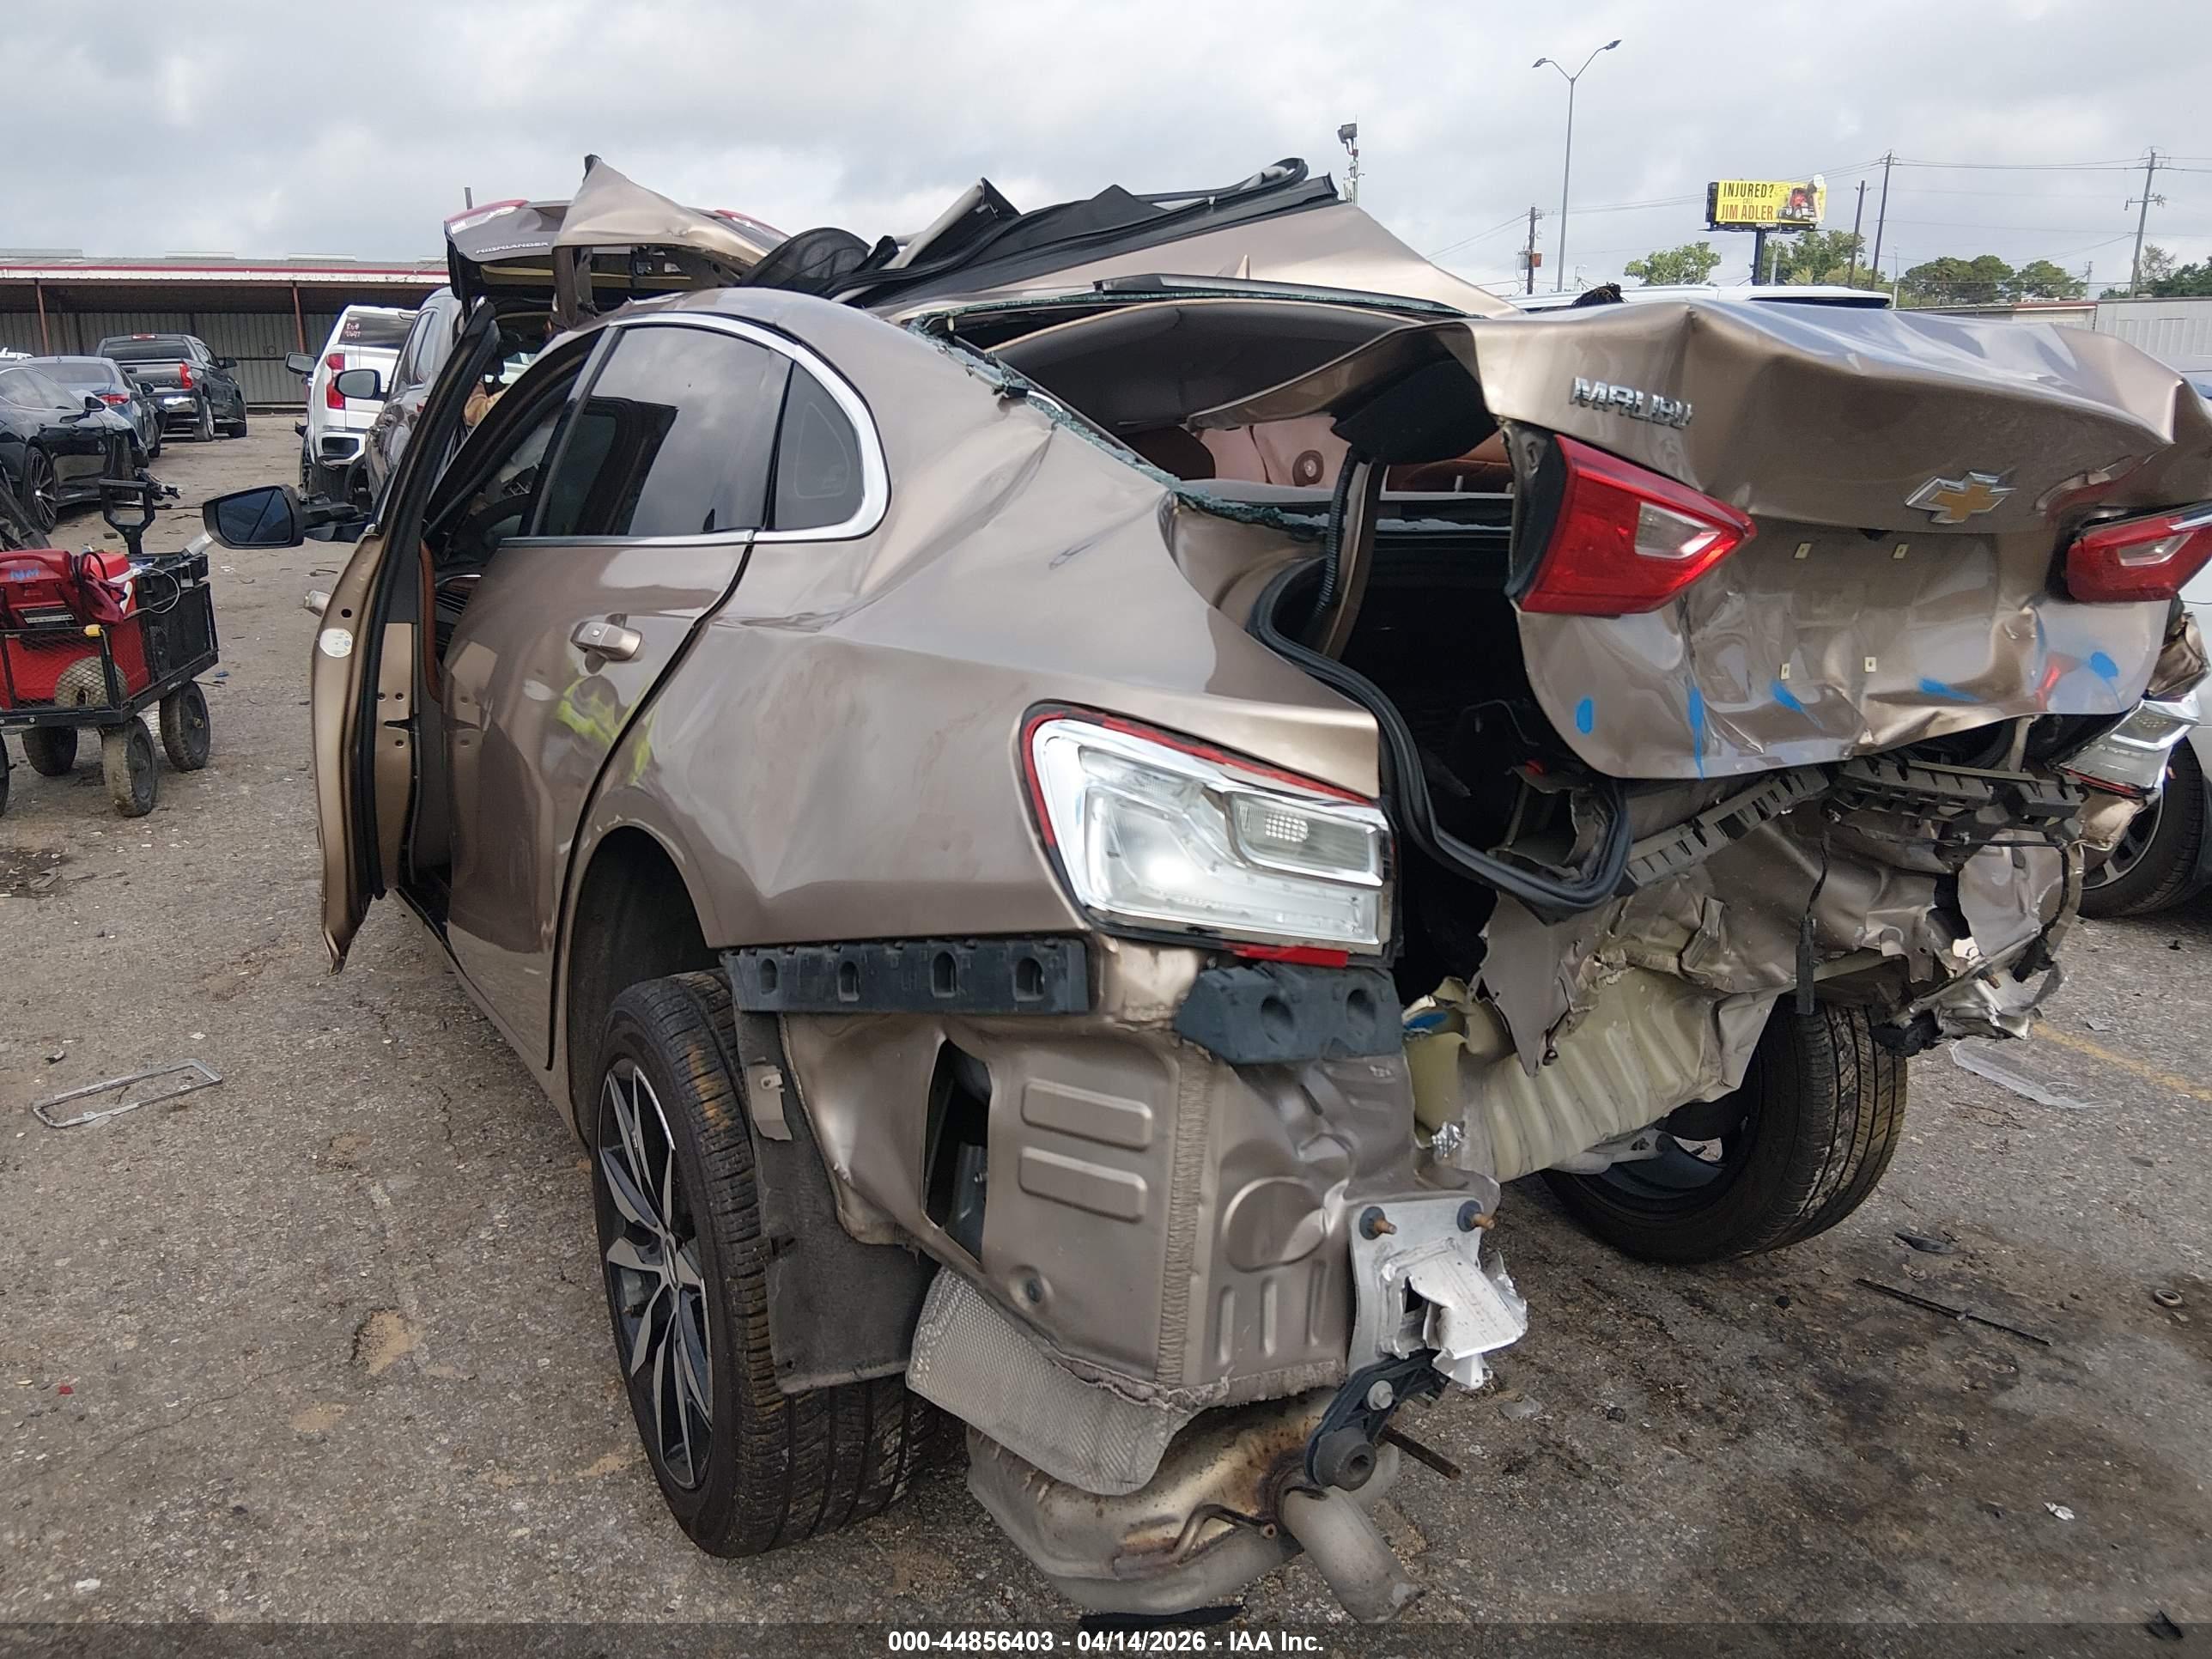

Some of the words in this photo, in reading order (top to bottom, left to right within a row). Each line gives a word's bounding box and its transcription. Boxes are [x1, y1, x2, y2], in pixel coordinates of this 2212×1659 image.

[1723, 183, 1774, 198] INJURED?
[1721, 204, 1738, 220] JIM
[1741, 204, 1773, 221] ADLER
[1569, 376, 1693, 429] MALIBU
